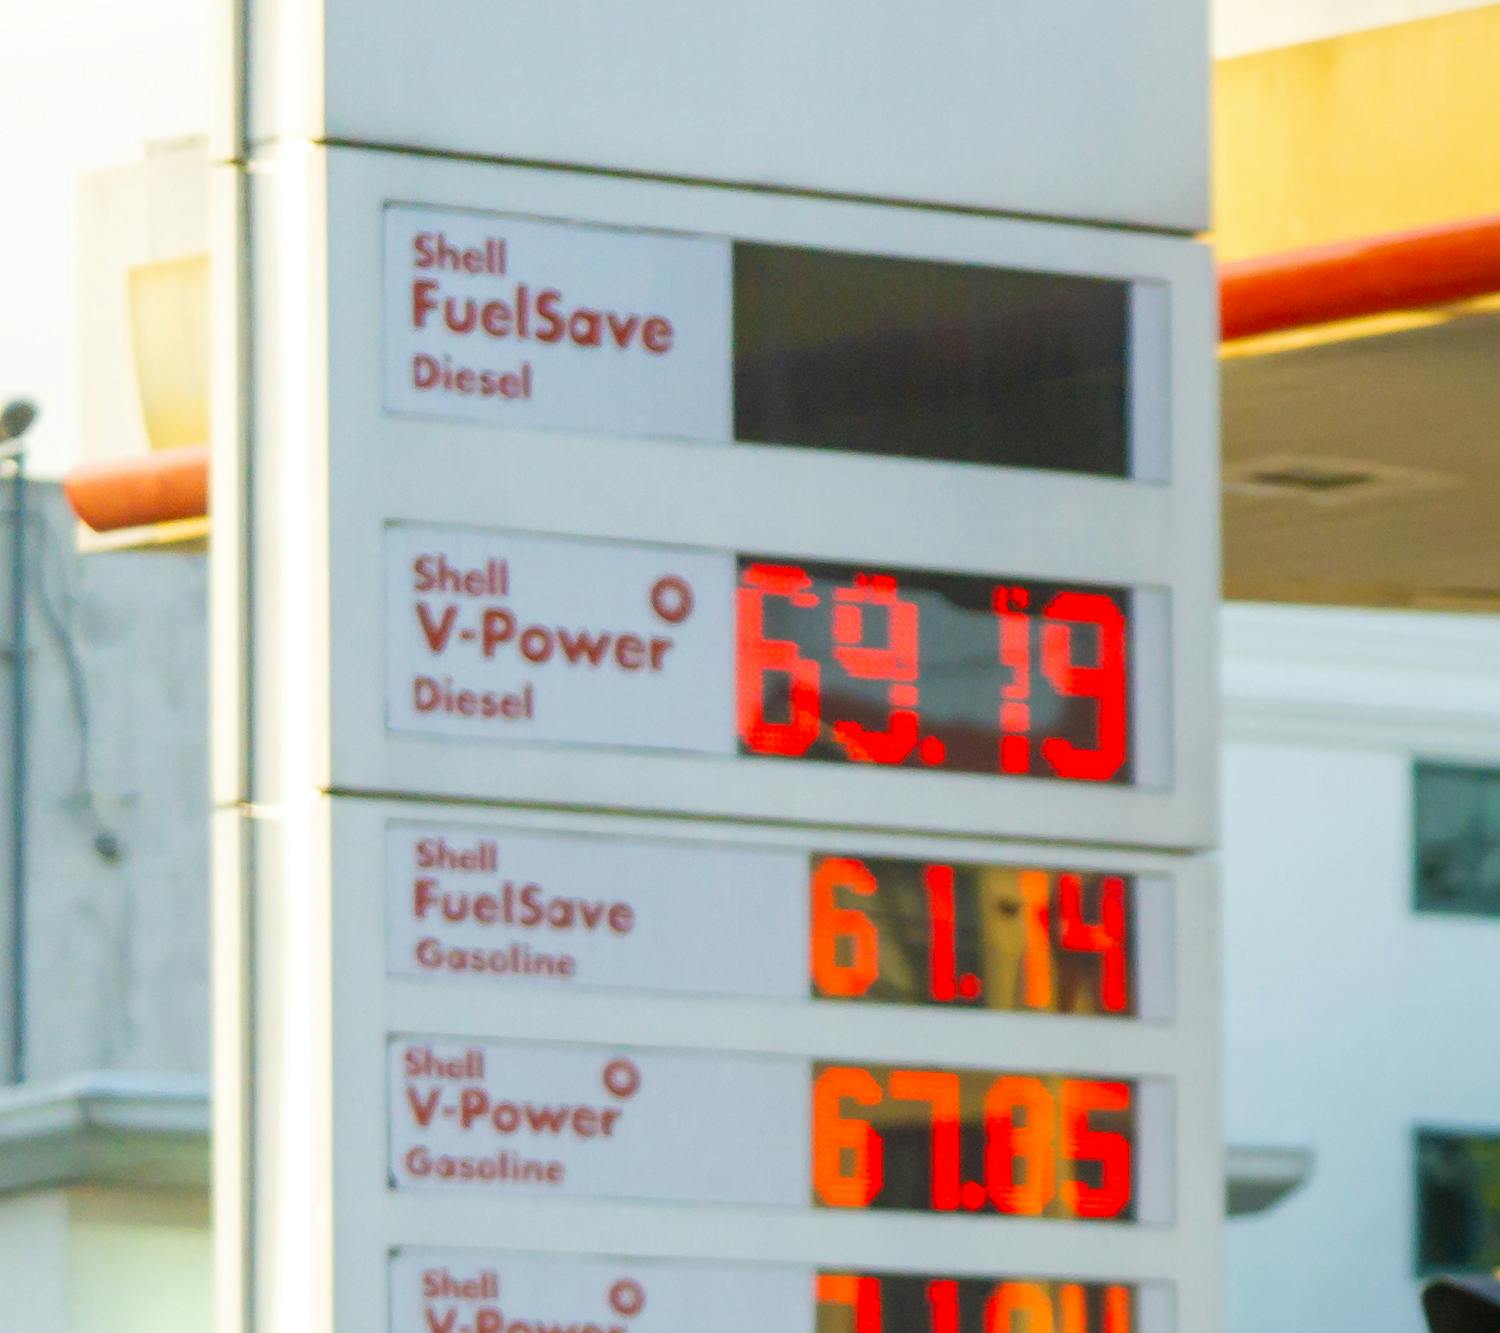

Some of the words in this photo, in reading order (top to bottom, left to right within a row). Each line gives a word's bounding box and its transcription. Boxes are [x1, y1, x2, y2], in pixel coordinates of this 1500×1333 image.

[413, 233, 505, 274] Shell
[411, 280, 673, 353] FuelSave
[412, 355, 531, 399] Diesel
[413, 557, 508, 597] Shell
[415, 605, 673, 671] V-Power
[413, 676, 532, 720] Diesel
[415, 838, 496, 875] Shell
[413, 879, 634, 936] FuelSave
[415, 941, 575, 979] Gasoline
[404, 1046, 483, 1082] Shell
[406, 1089, 618, 1138] V-Power
[812, 1066, 1131, 1218] 67.85
[405, 1149, 563, 1186] Gasoline
[423, 1271, 498, 1302] Shell
